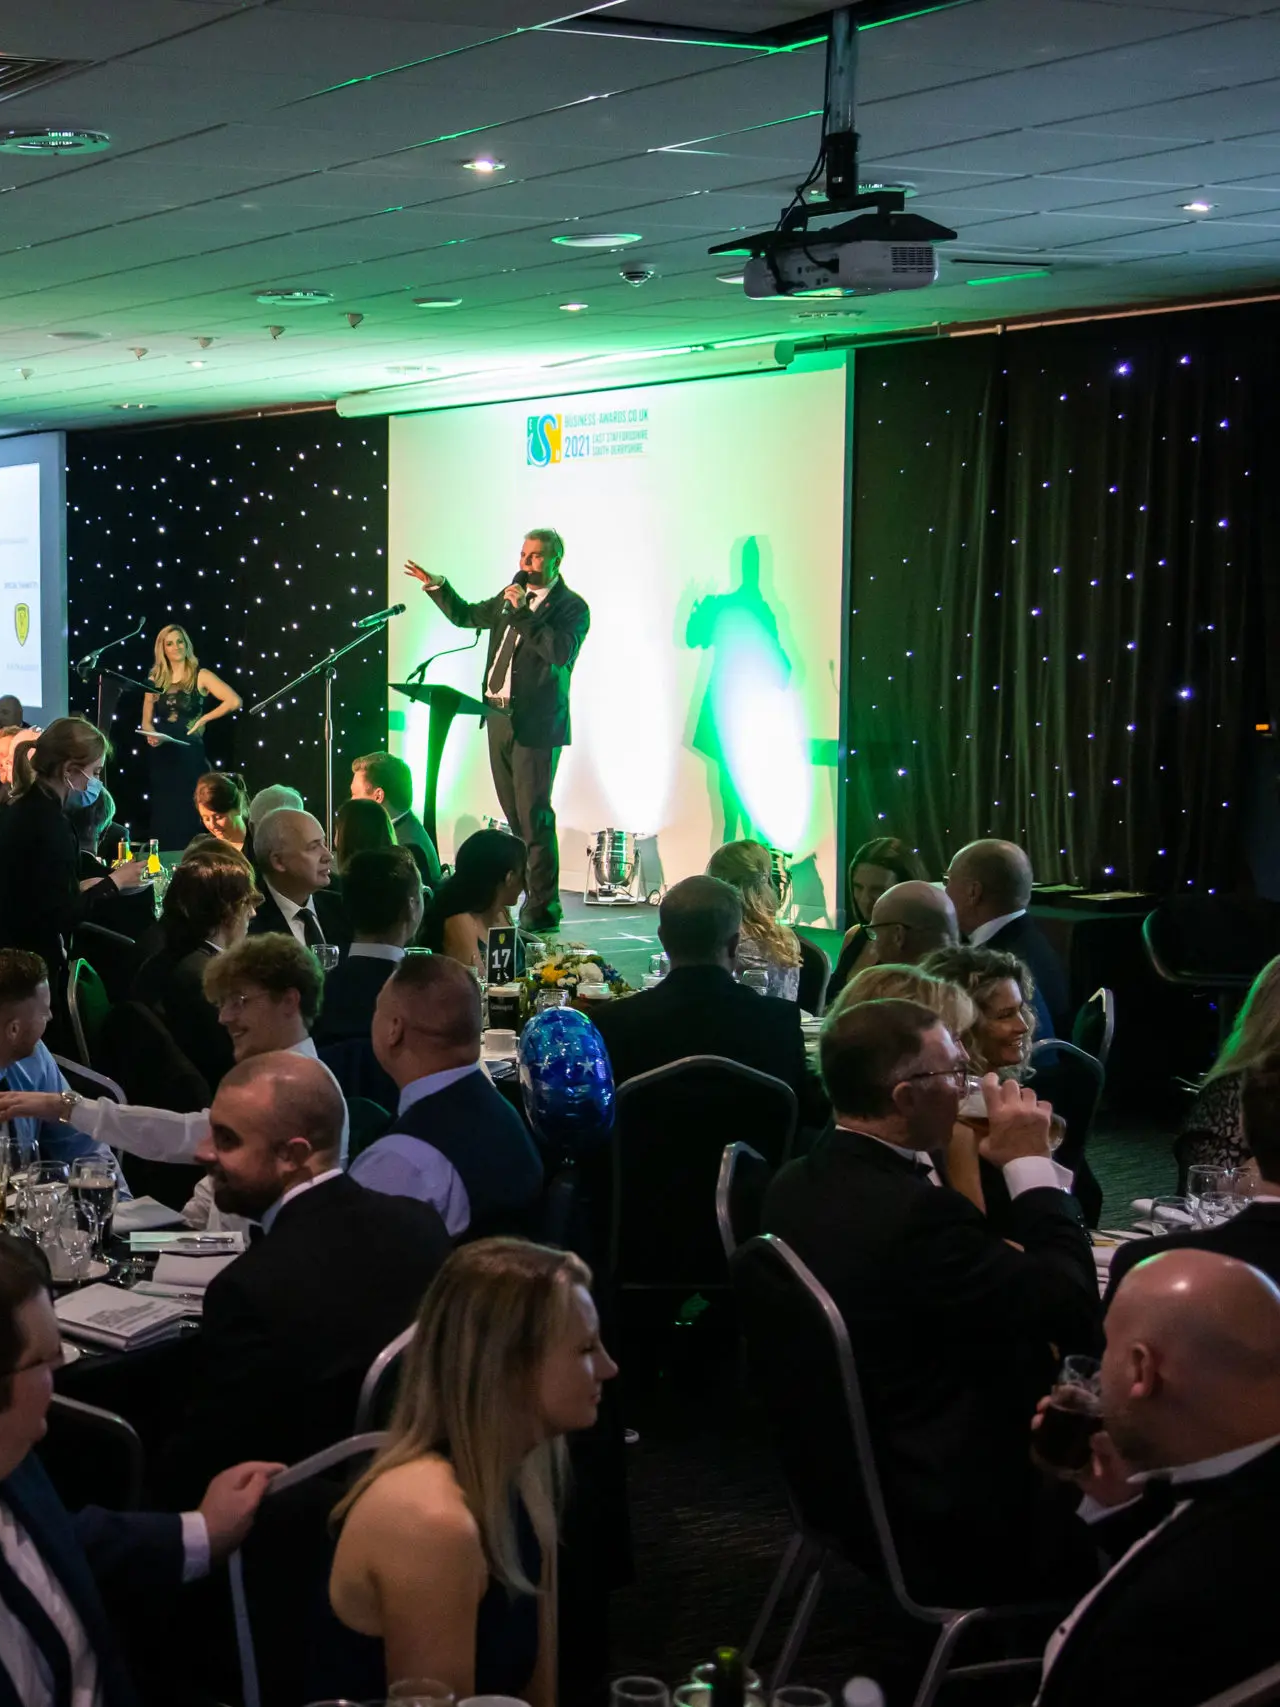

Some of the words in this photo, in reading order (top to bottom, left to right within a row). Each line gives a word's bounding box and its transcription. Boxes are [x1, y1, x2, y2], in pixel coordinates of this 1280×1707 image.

[564, 414, 596, 428] BUSINESS
[564, 435, 590, 458] 2021
[491, 948, 512, 969] 17
